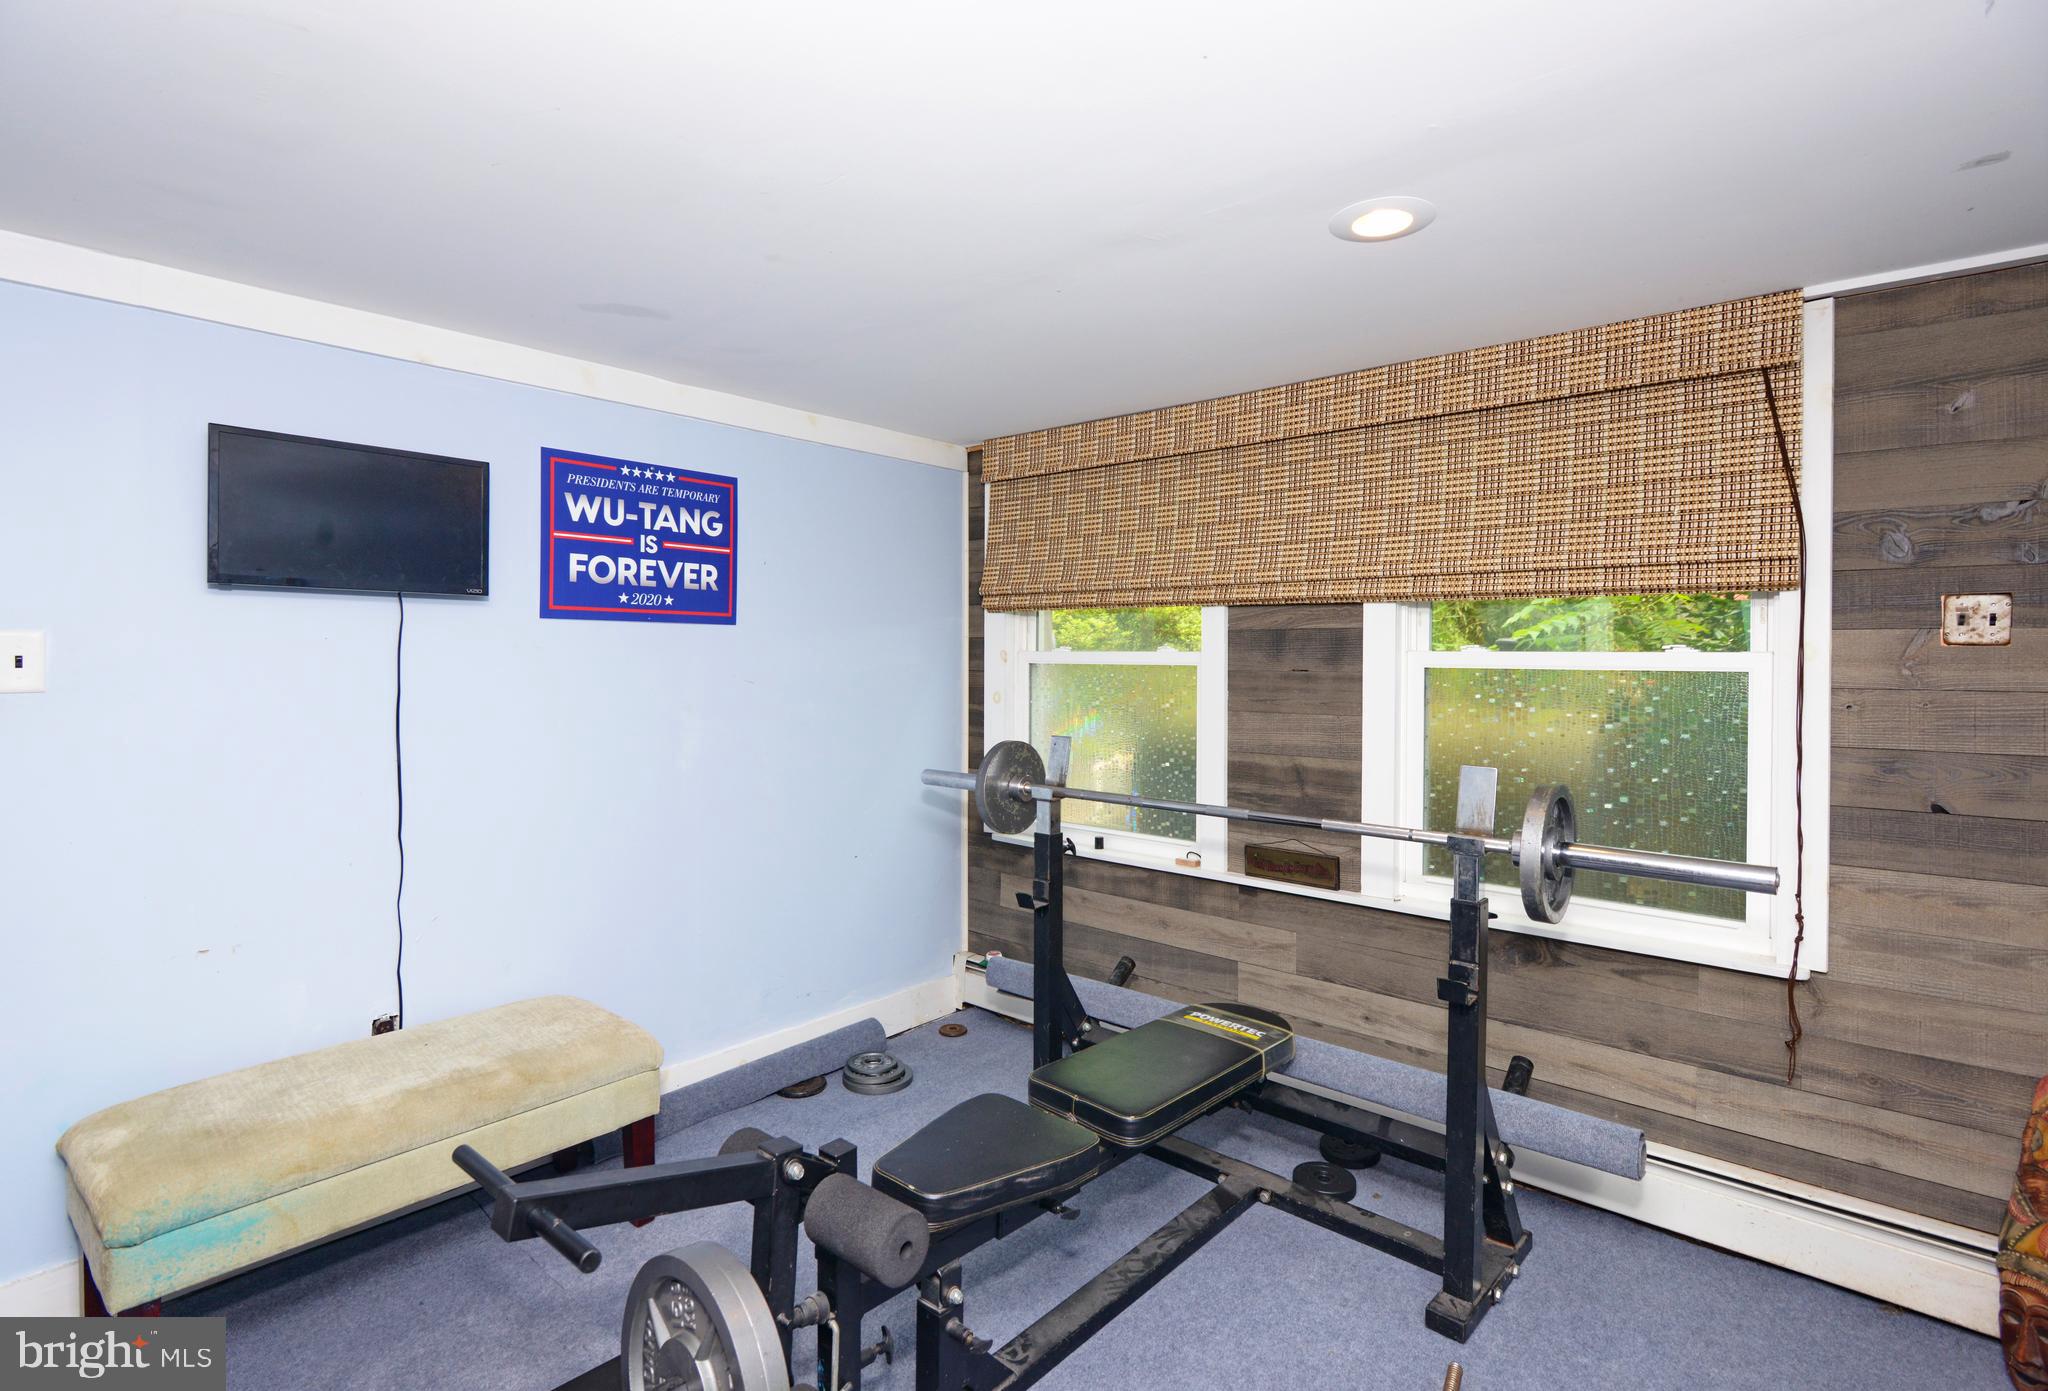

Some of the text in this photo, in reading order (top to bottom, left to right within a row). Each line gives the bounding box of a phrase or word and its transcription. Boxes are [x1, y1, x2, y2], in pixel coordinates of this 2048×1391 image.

[566, 473, 720, 504] PRESIDENTS ARE TEMPORARY
[564, 491, 723, 537] WU-TANG
[640, 534, 658, 554] IS
[569, 552, 718, 592] FOREVER
[631, 593, 662, 607] 2020
[1190, 1011, 1266, 1037] POWERTEC
